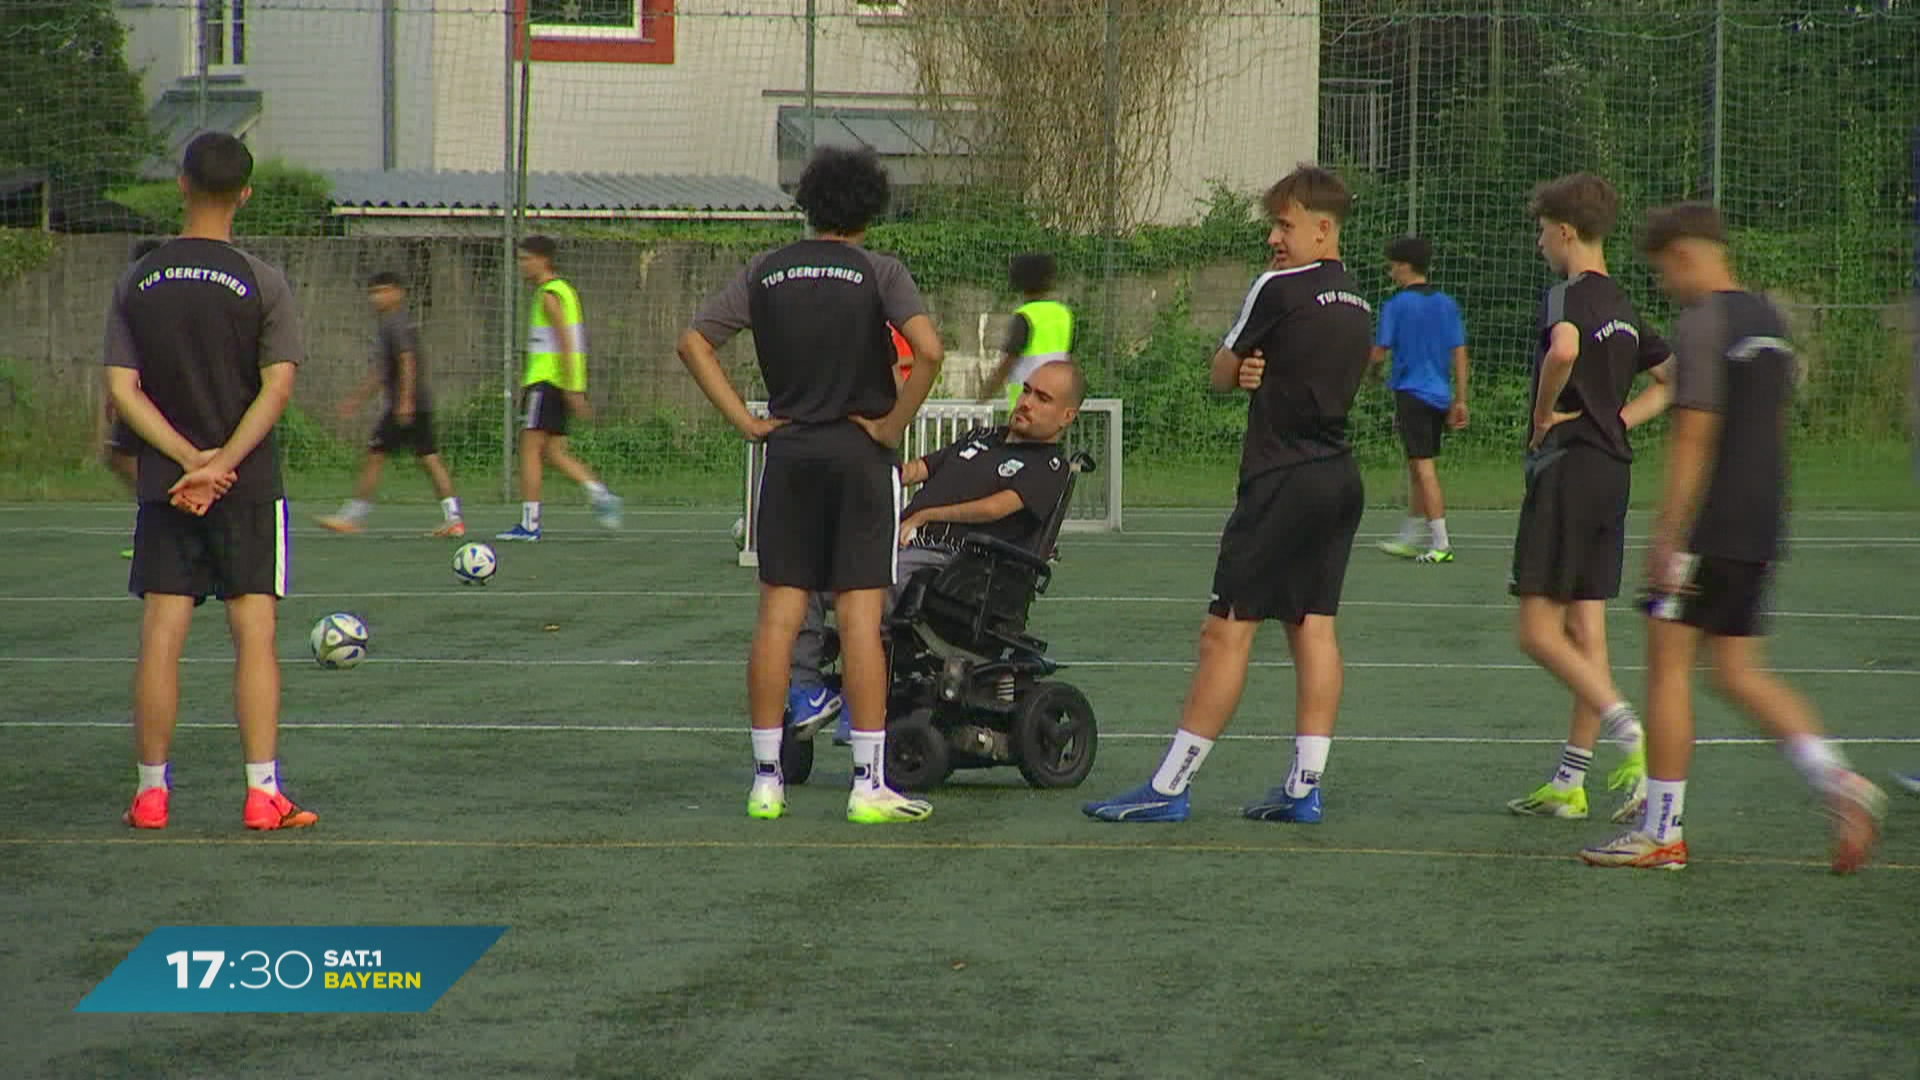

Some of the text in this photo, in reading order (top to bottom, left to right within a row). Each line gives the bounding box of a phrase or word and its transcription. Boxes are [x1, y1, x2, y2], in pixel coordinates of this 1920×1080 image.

[138, 267, 248, 297] TUS GERETSRIED
[761, 266, 864, 288] TUS GERETSRIED
[1316, 290, 1337, 306] TUS
[1595, 321, 1614, 343] TUS
